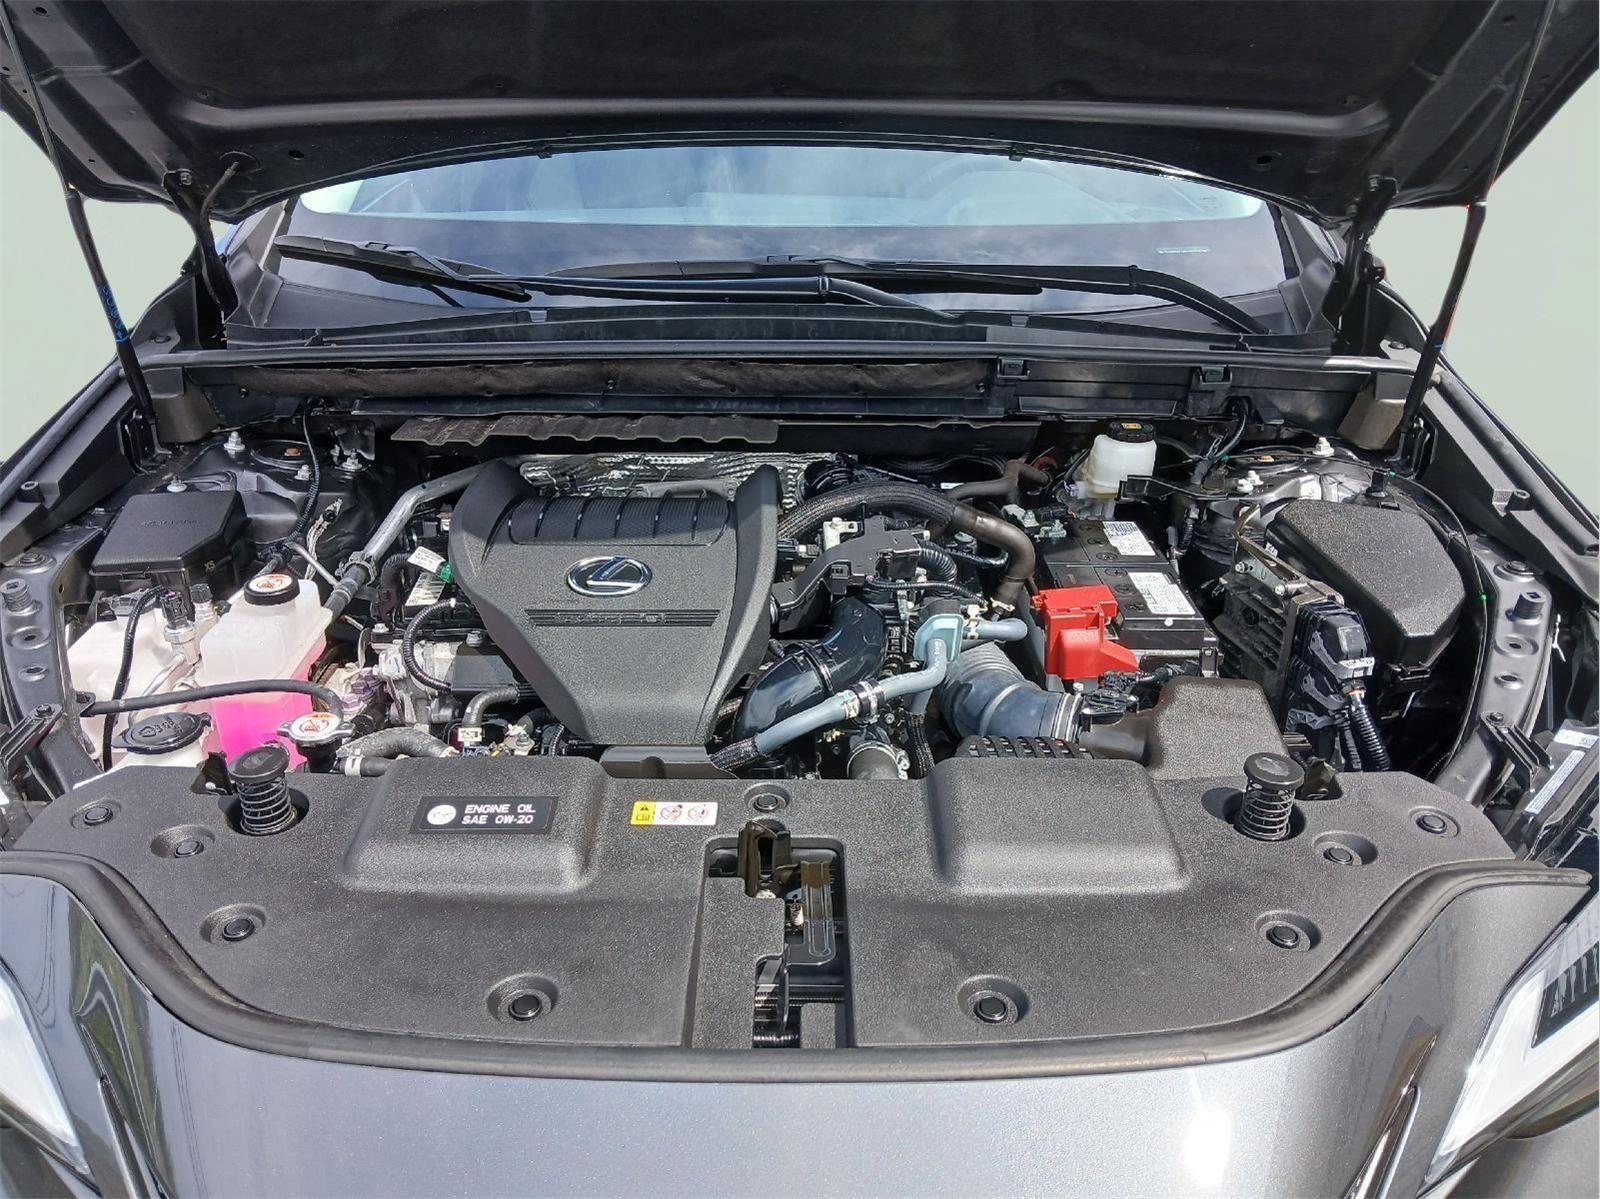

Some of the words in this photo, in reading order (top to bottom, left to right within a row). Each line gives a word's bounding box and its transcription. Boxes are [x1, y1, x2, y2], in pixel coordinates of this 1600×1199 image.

[464, 804, 511, 814] ENGINE
[517, 803, 536, 813] OIL
[462, 815, 489, 825] SAE
[495, 815, 534, 824] 0W-20
